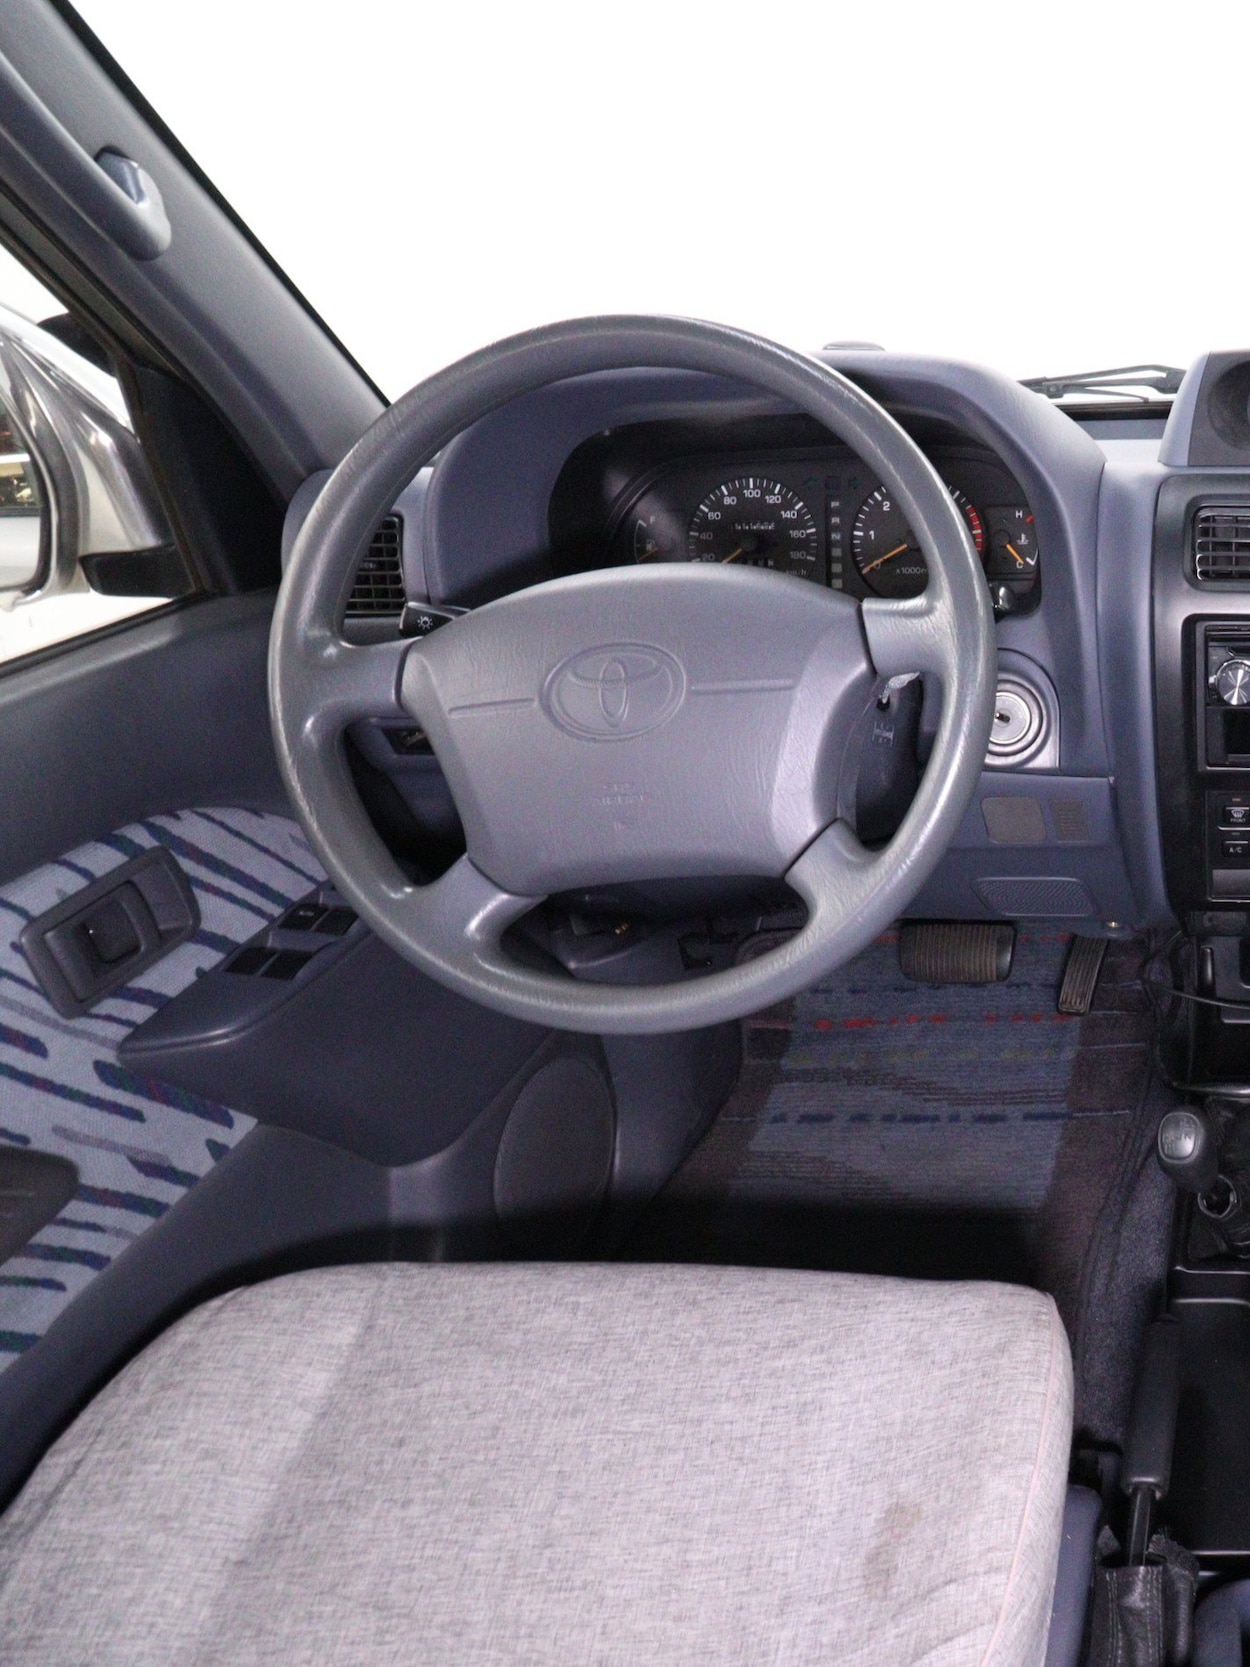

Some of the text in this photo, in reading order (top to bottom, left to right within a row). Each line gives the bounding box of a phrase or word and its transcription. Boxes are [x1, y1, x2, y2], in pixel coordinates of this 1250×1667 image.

[743, 489, 761, 498] 100
[723, 496, 737, 505] 80
[764, 495, 782, 504] 120
[882, 501, 891, 511] 2
[707, 511, 721, 520] 60
[780, 510, 798, 519] 140
[1015, 510, 1023, 518] H
[699, 532, 713, 540] 40
[789, 530, 806, 538] 160
[869, 530, 875, 540] 1
[702, 553, 715, 561] 20
[789, 551, 806, 559] 180
